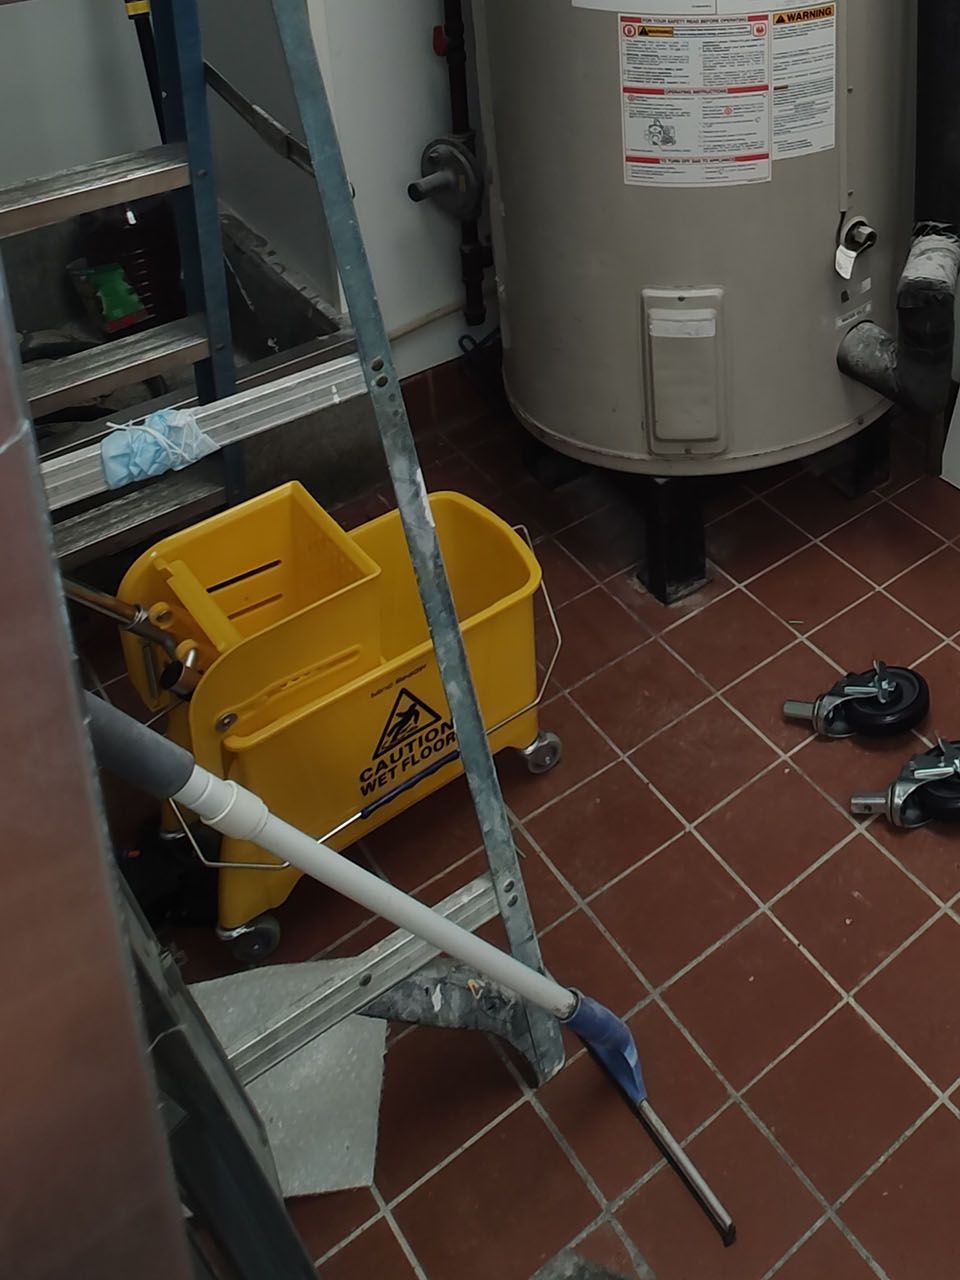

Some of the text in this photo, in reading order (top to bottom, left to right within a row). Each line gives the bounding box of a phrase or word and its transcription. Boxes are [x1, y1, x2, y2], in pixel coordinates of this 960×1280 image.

[787, 7, 832, 22] WARNING
[359, 717, 454, 783] CAUTION
[360, 731, 456, 797] WET FLOOR
